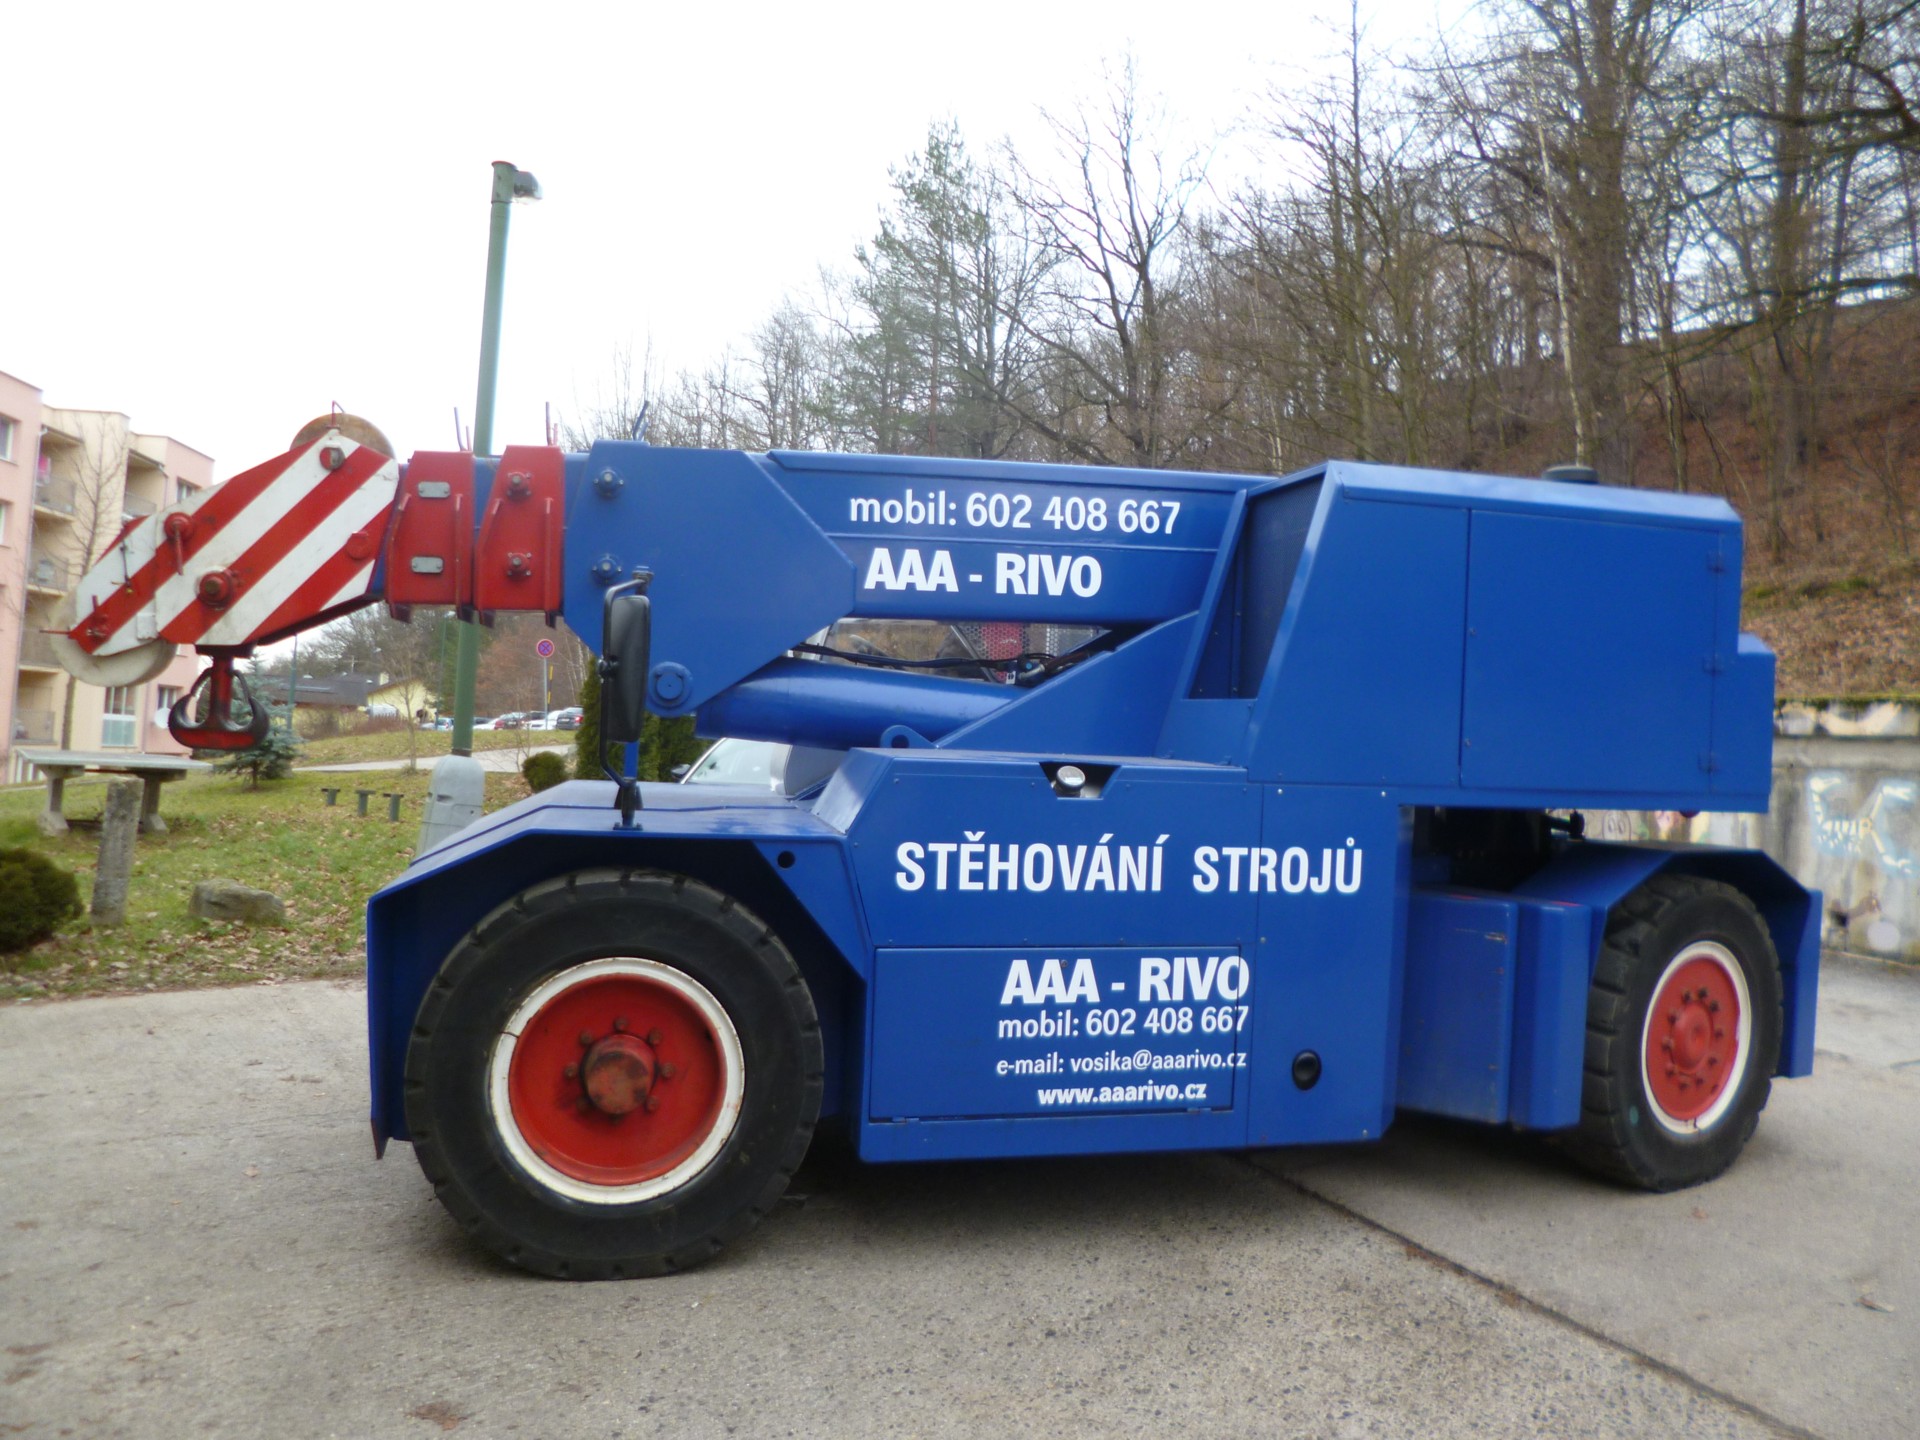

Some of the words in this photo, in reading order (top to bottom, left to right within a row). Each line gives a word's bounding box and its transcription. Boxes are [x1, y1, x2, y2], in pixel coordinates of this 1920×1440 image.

[850, 488, 957, 527] mobil:
[965, 491, 1033, 529] 602
[1042, 495, 1108, 532] 408
[1117, 498, 1182, 535] 667
[863, 547, 960, 593] AAA
[969, 573, 983, 583] -
[995, 552, 1103, 598] RIVO
[895, 830, 1170, 893] STĚHOVÁNÍ
[1192, 837, 1363, 895] STROJŮ
[1000, 958, 1101, 1005] AAA
[1111, 982, 1125, 991] -
[1138, 955, 1250, 1002] RIVO
[998, 1009, 1079, 1038] mobil:
[1085, 1008, 1137, 1036] 602
[1143, 1006, 1193, 1034] 408
[1201, 1005, 1249, 1033] 667
[996, 1051, 1064, 1075] e-mail:
[1070, 1049, 1247, 1072] vosika@aaarivo.cz
[1037, 1079, 1207, 1105] www.aaarivo.cz
